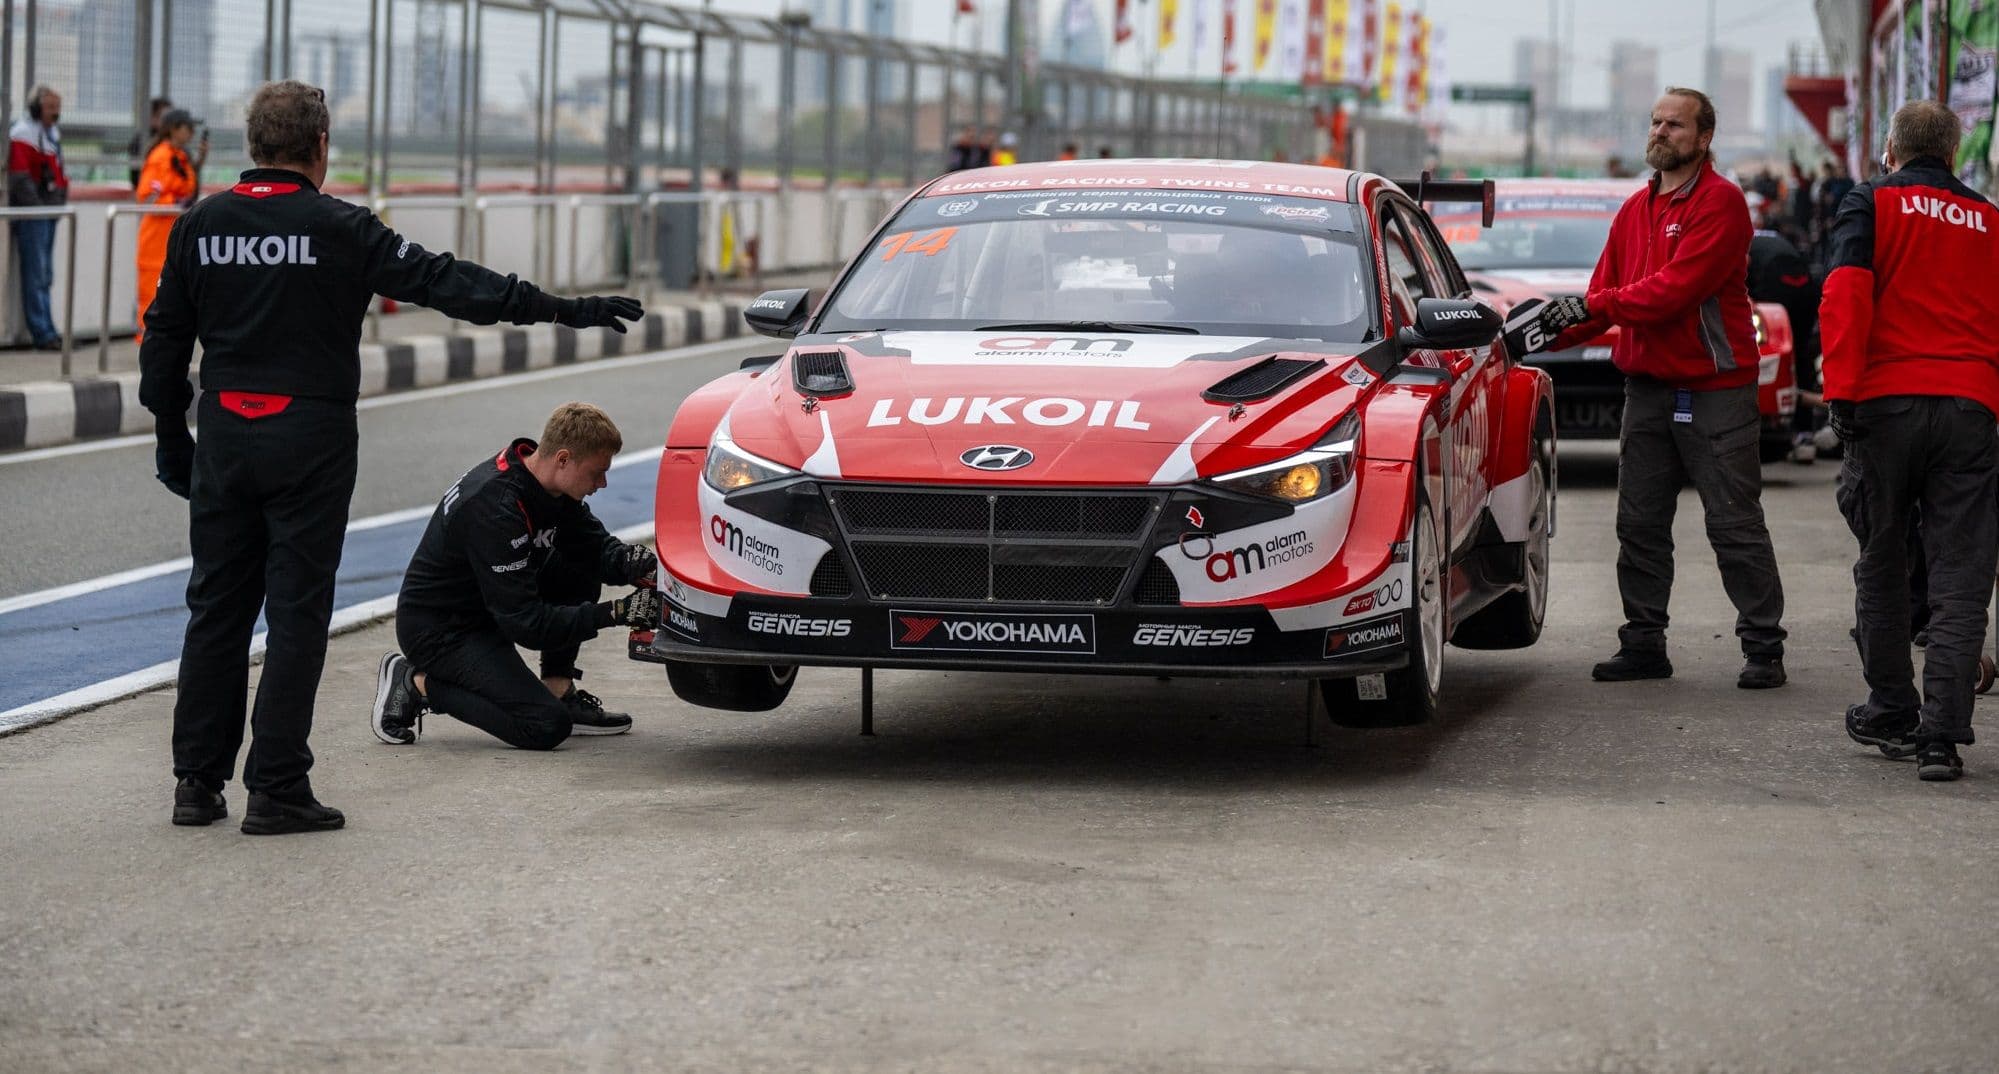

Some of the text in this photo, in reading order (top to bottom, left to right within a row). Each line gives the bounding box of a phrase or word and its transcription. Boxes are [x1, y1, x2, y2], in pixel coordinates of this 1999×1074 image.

[939, 177, 1336, 197] LUKOIL RACING TWINS TEAM
[1056, 201, 1228, 216] SMP RACING
[1900, 195, 1987, 233] LUKOIL
[197, 235, 317, 266] LUKOIL
[879, 226, 960, 263] 14
[752, 299, 786, 310] LUKOIL
[1434, 309, 1482, 321] LUKOIL
[978, 337, 1134, 351] am
[866, 396, 1152, 431] LUKOIL
[711, 514, 744, 557] am
[745, 535, 780, 559] alarm
[1265, 530, 1307, 552] alarm
[743, 550, 785, 576] motors
[1205, 542, 1266, 583] am
[1267, 541, 1314, 567] motors
[747, 615, 852, 637] GENESIS
[942, 621, 1087, 644] YOKOHAMA
[1132, 628, 1256, 647] GENESIS
[1346, 623, 1401, 646] YOKOHAMA
